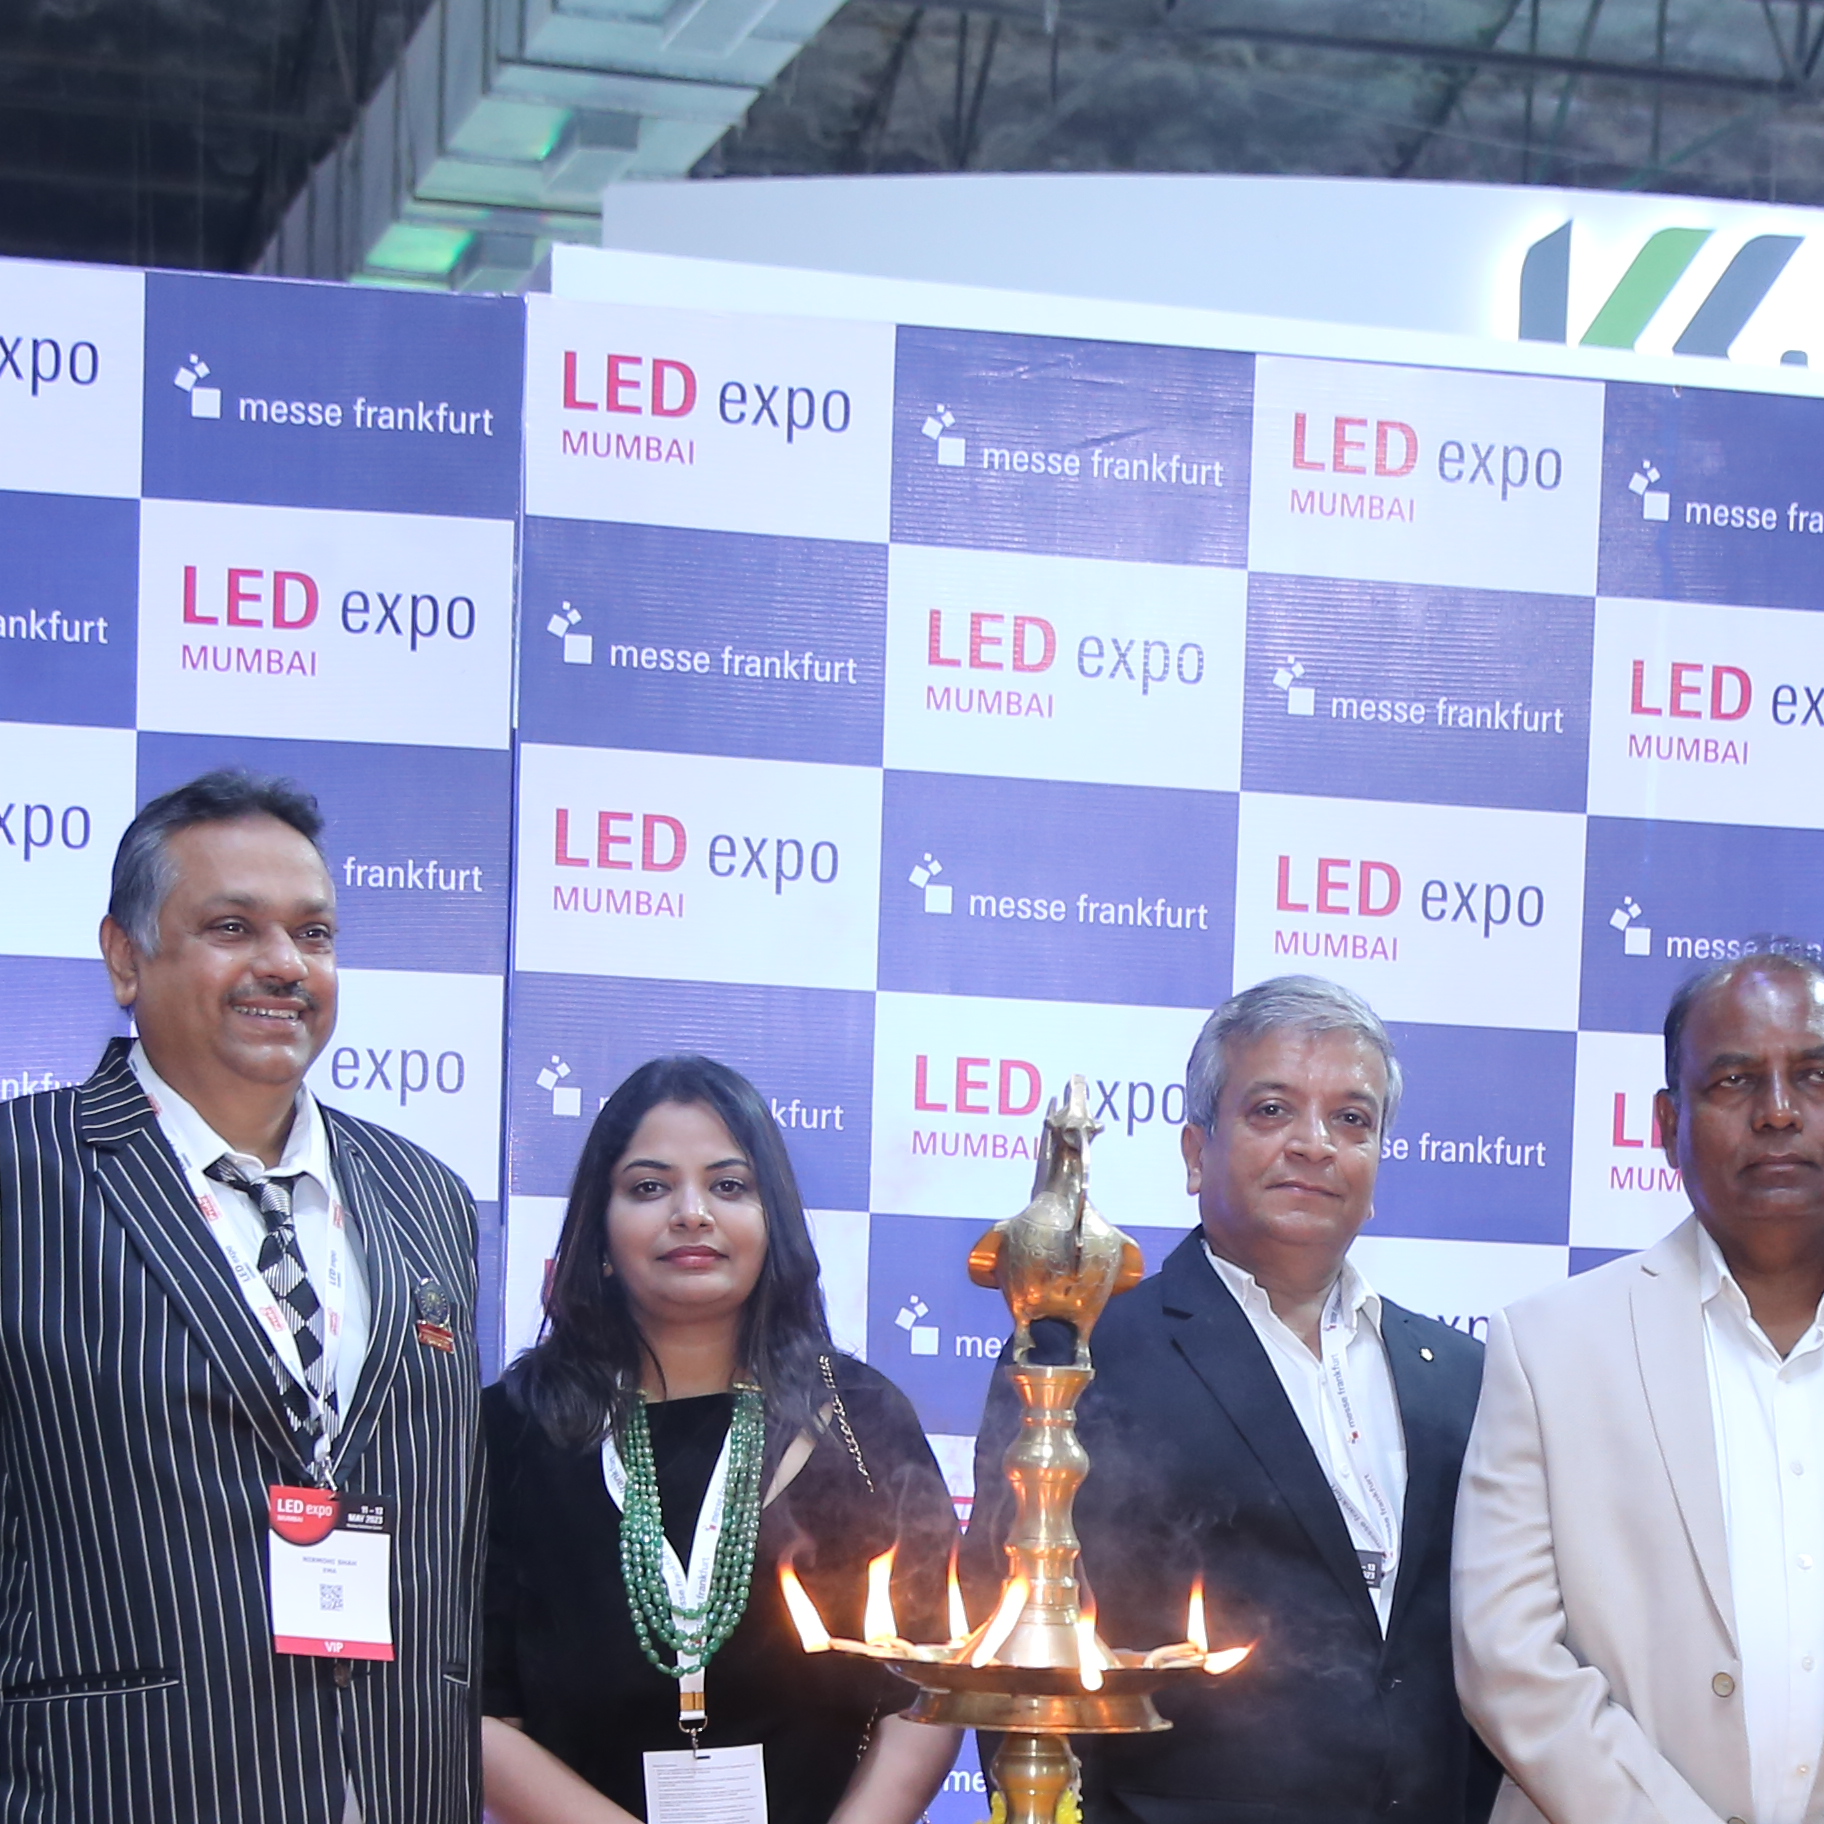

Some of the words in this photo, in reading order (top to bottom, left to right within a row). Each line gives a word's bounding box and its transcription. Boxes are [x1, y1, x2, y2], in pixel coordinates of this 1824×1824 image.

[564, 351, 697, 418] LED
[719, 382, 850, 443] expo
[240, 398, 342, 426] messe
[353, 397, 493, 435] frankfurt
[563, 429, 694, 464] MUMBAI
[1293, 412, 1418, 477] LED
[1439, 441, 1562, 501] expo
[978, 448, 1080, 476] messe
[1091, 448, 1223, 487] frankfurt
[1291, 489, 1414, 522] MUMBAI
[1686, 502, 1777, 530] messe
[183, 565, 319, 629] LED
[342, 591, 475, 651] expo
[182, 644, 316, 676] MUMBAI
[611, 645, 710, 673] messe
[721, 646, 857, 684] frankfurt
[928, 609, 1056, 673] LED
[1078, 636, 1204, 696] expo
[927, 685, 1053, 718] MUMBAI
[1631, 660, 1752, 721] LED
[1332, 695, 1425, 724] messe
[1436, 696, 1563, 733] frankfurt
[1629, 734, 1748, 764] MUMBAI
[555, 808, 686, 872] LED
[709, 834, 838, 895] expo
[343, 857, 482, 892] frankfurt
[554, 886, 683, 917] MUMBAI
[970, 895, 1066, 921] messe
[1076, 894, 1208, 929] frankfurt
[1277, 855, 1401, 917] LED
[1422, 880, 1543, 938] expo
[1275, 930, 1397, 961] MUMBAI
[332, 1047, 464, 1106] expo
[914, 1055, 1042, 1116] LED
[772, 1099, 846, 1131] kfurt
[1419, 1133, 1546, 1166] frankfurt
[1611, 1166, 1682, 1192] MUM
[1331, 1352, 1346, 1397] frankfurt
[1342, 1393, 1356, 1428] messe
[277, 1498, 303, 1514] LED
[306, 1504, 333, 1518] expo
[347, 1513, 365, 1524] MAY
[324, 1641, 344, 1653] VIP
